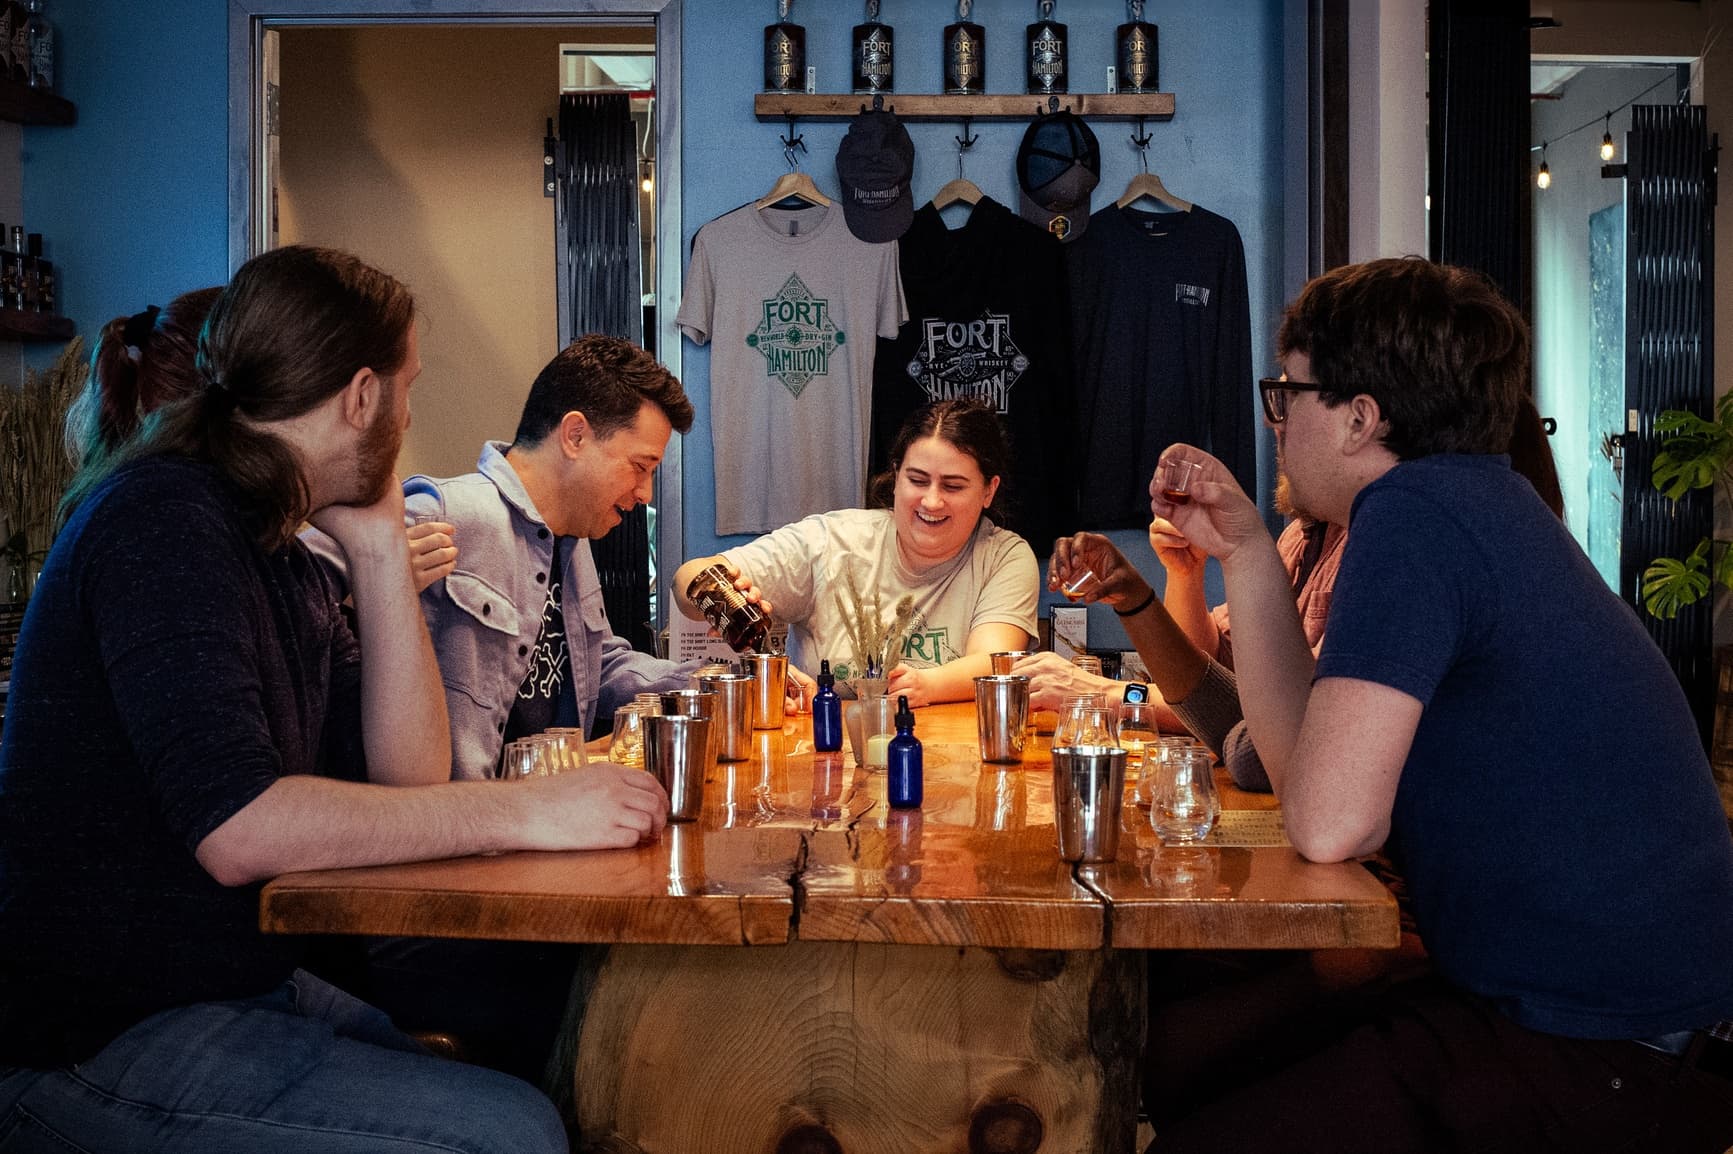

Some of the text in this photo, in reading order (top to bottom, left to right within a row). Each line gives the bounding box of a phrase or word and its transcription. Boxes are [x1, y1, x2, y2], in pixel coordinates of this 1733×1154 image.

[863, 41, 892, 56] FORT
[1032, 40, 1063, 55] FORT
[1032, 59, 1064, 75] HAMILTON
[766, 301, 826, 333] FORT
[805, 332, 818, 340] DRY
[821, 333, 832, 341] GIN
[926, 318, 1007, 361] FORT
[768, 342, 826, 372] HAMILTON
[978, 359, 1009, 367] WHISKEY
[900, 632, 945, 665] RT
